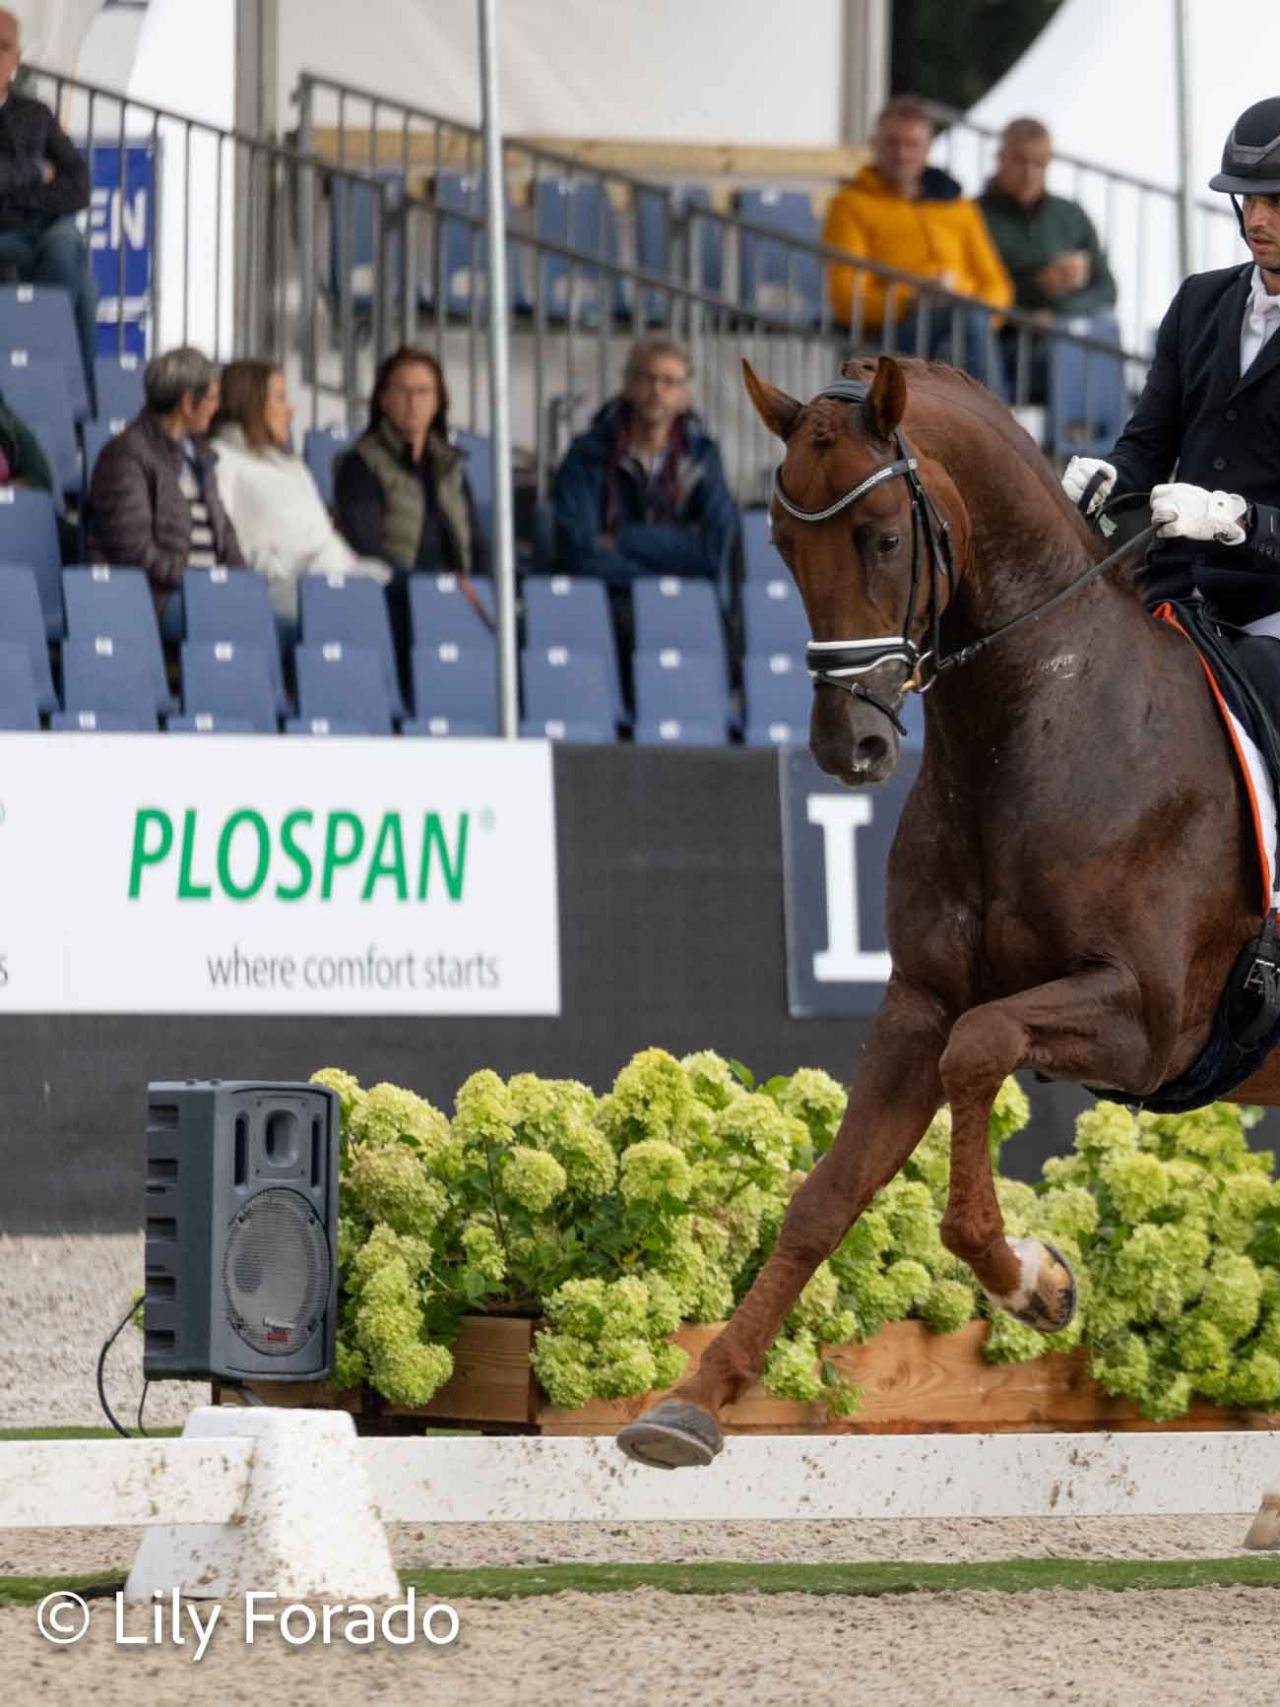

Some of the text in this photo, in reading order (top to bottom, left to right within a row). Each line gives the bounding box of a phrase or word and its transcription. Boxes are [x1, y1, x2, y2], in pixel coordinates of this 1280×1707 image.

[128, 806, 470, 902] PLOSPAN
[206, 943, 500, 989] where comfort starts
